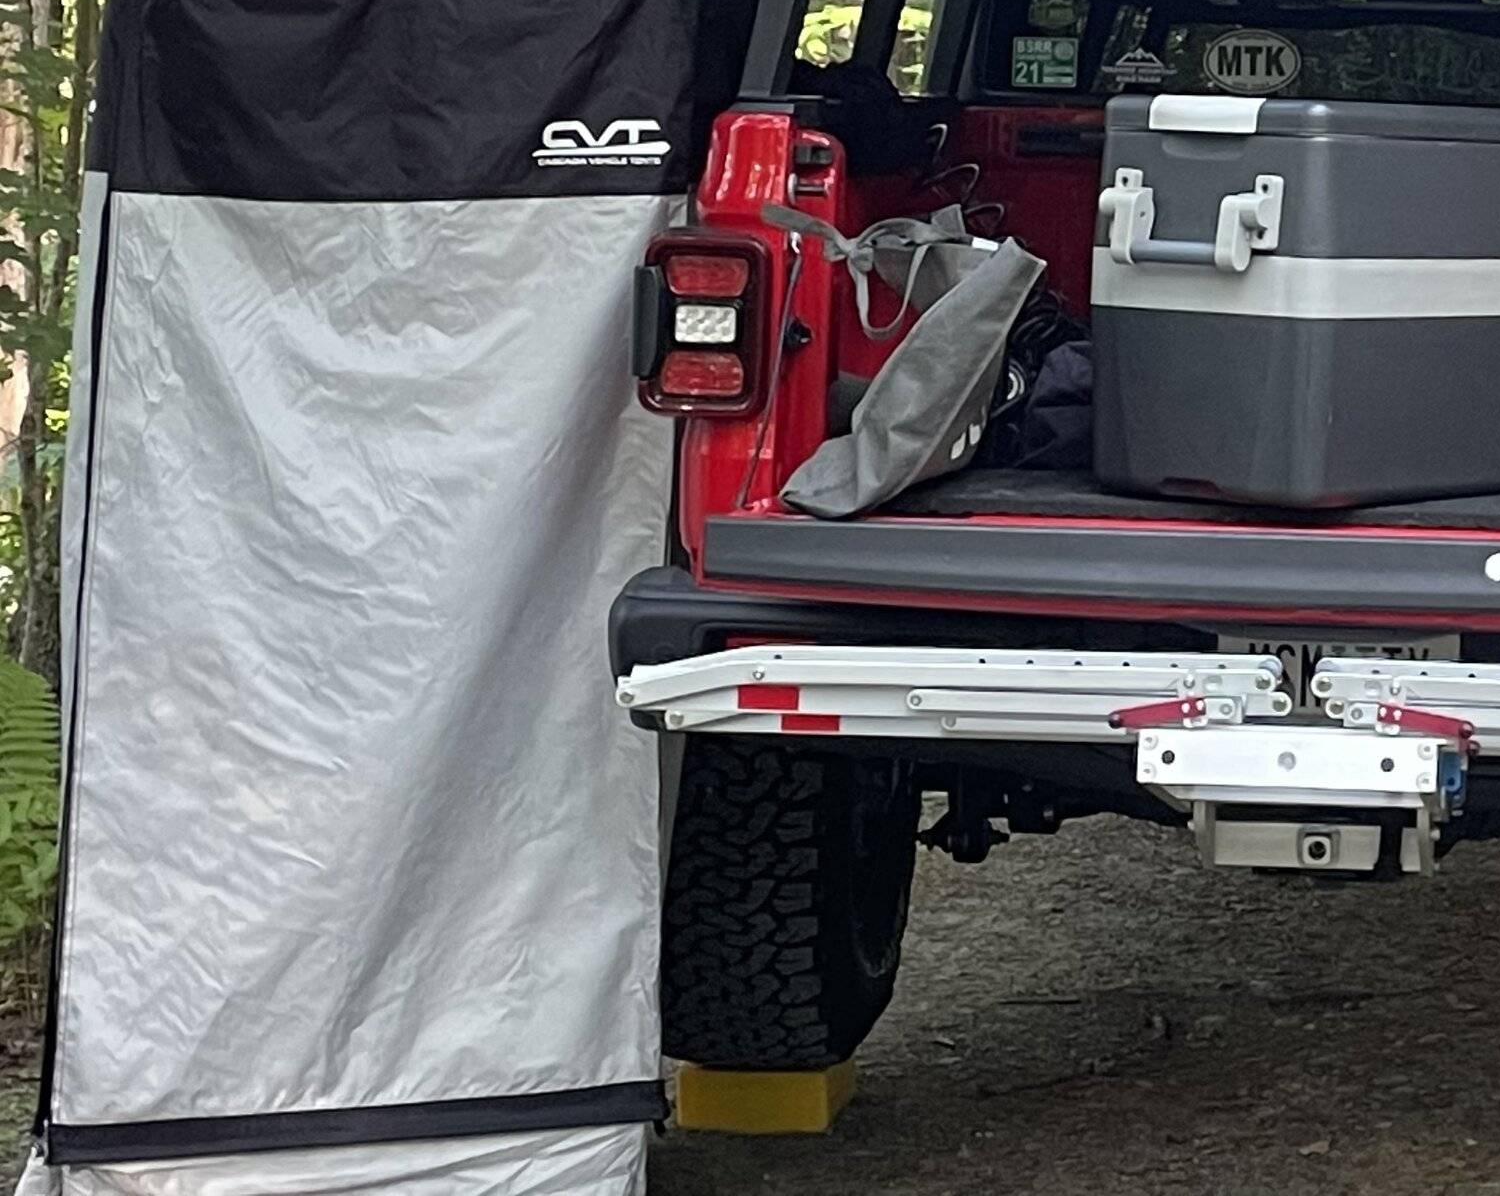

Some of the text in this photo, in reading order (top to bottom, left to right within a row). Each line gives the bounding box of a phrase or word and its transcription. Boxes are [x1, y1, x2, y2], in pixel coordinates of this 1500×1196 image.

[1015, 61, 1039, 83] 21
[1217, 45, 1286, 76] MTK
[542, 119, 661, 149] CVT
